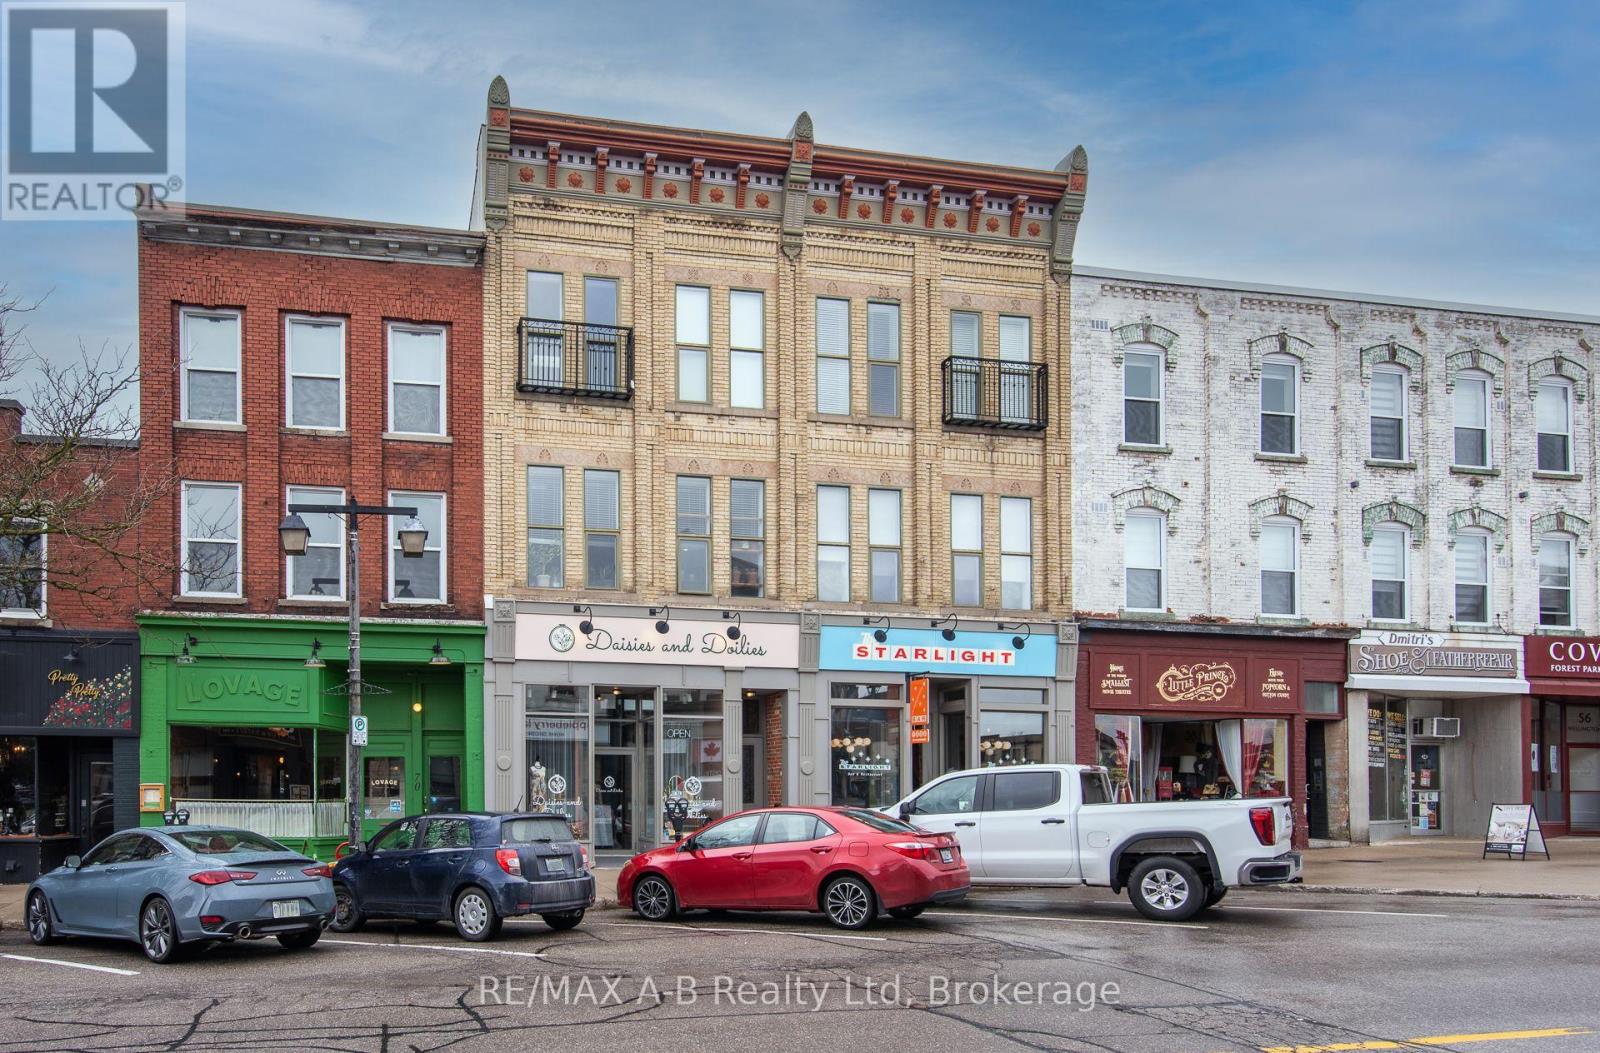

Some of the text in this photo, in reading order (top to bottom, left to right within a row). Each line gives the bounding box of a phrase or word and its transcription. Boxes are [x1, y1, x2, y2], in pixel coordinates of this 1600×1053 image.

[585, 628, 767, 656] Daisies and Doilies
[860, 631, 876, 646] Th
[1389, 632, 1434, 646] Dmitri's
[856, 645, 1012, 664] STARLIGHT
[1357, 645, 1409, 672] SHOE
[1427, 650, 1474, 668] LEATHER
[1474, 652, 1514, 671] REPAIR
[1550, 664, 1580, 672] FOREST
[48, 669, 79, 685] Pretty
[1195, 670, 1229, 688] PRINCE
[71, 682, 100, 697] Pretty
[185, 676, 302, 707] LOVAGE
[1261, 683, 1287, 691] POPCORN
[1578, 712, 1592, 724] 56
[667, 729, 691, 738] OPEN
